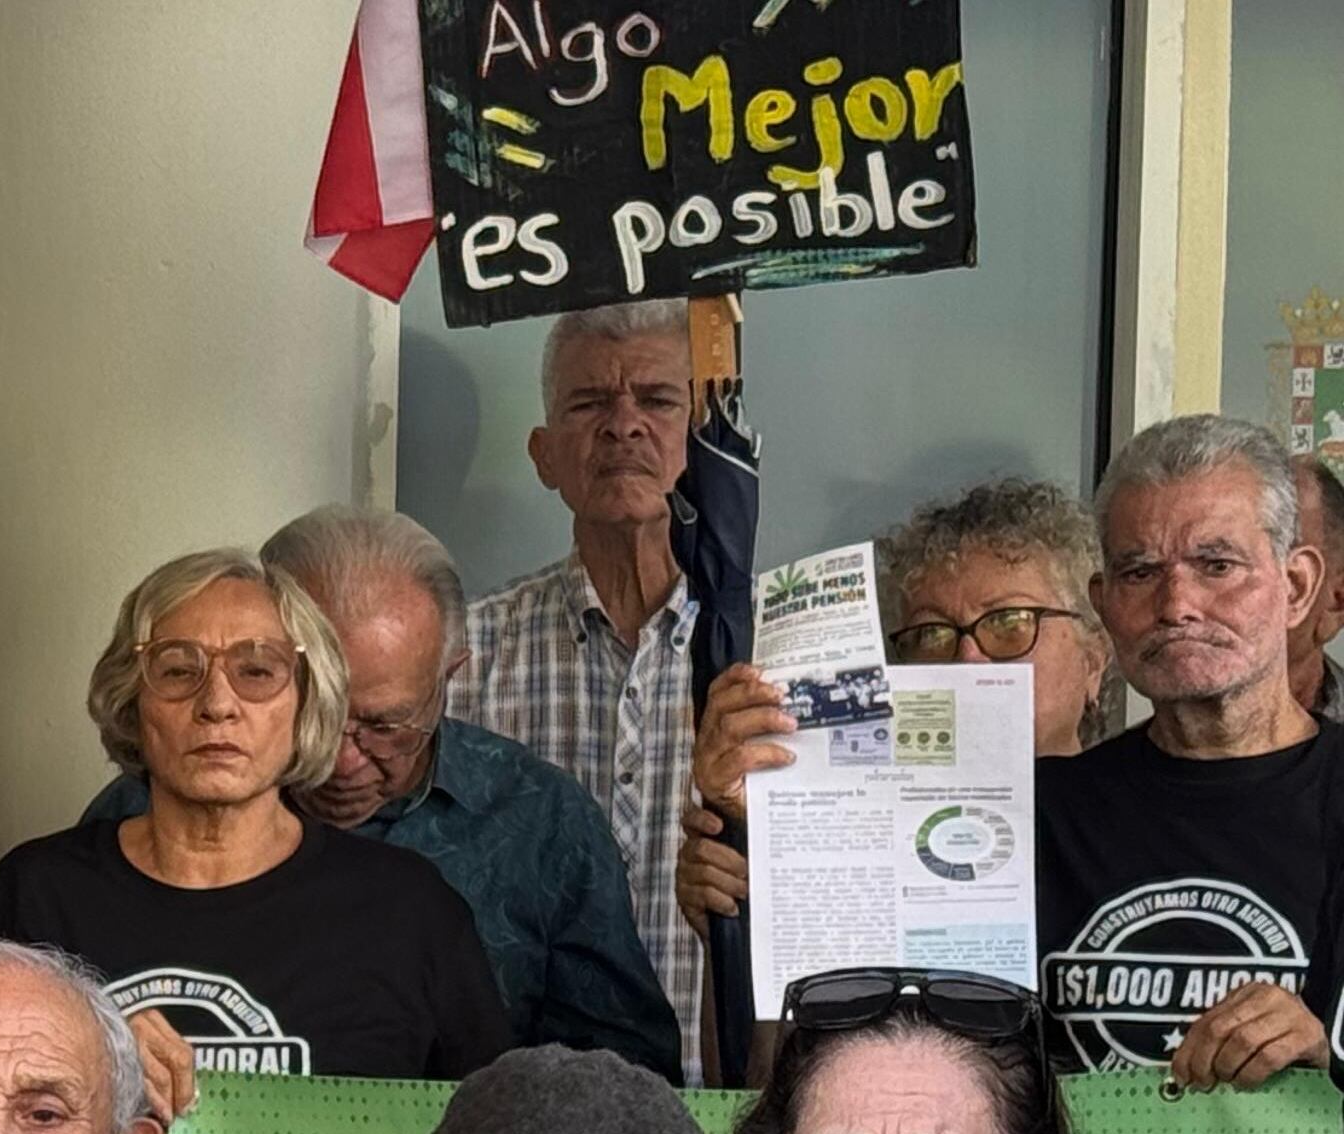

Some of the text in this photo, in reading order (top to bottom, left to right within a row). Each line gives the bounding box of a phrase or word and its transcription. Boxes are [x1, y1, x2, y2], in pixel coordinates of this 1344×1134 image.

[481, 0, 661, 106] Algo
[640, 56, 962, 189] Mejor
[1087, 891, 1291, 953] CONSTRUYAMOS OTRO ACUERDO
[1057, 964, 1174, 1010] ¡$1,000
[196, 1047, 290, 1075] HORA!
